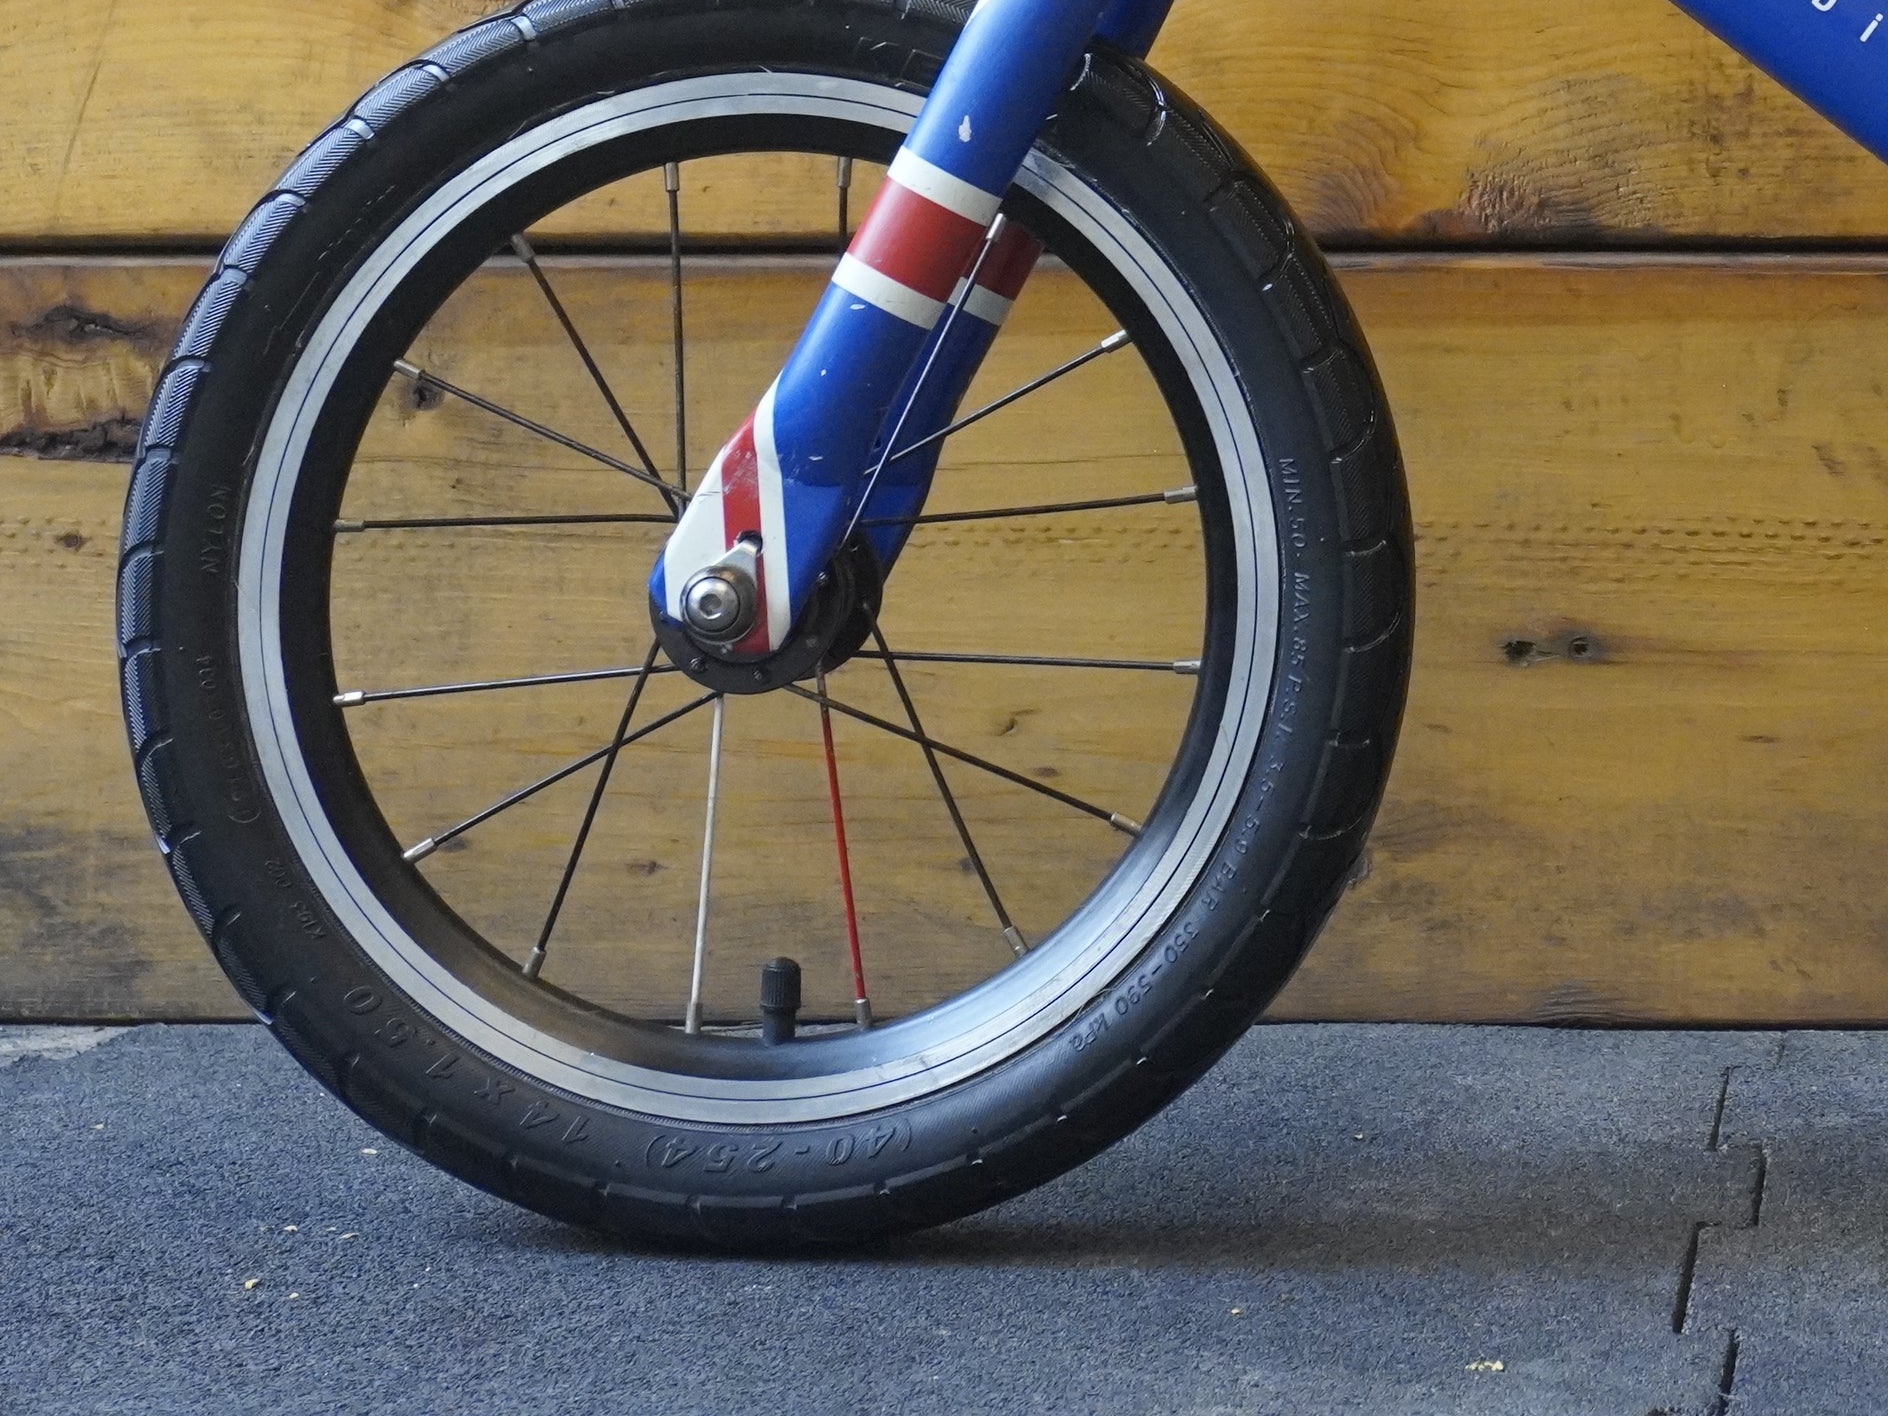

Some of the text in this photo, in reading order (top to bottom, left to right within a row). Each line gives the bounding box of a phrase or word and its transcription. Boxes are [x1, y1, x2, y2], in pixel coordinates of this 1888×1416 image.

[1199, 861, 1238, 914] BAR
[340, 982, 462, 1084] 1.50
[519, 1098, 592, 1147] 14
[643, 1119, 916, 1173] (40-254)
